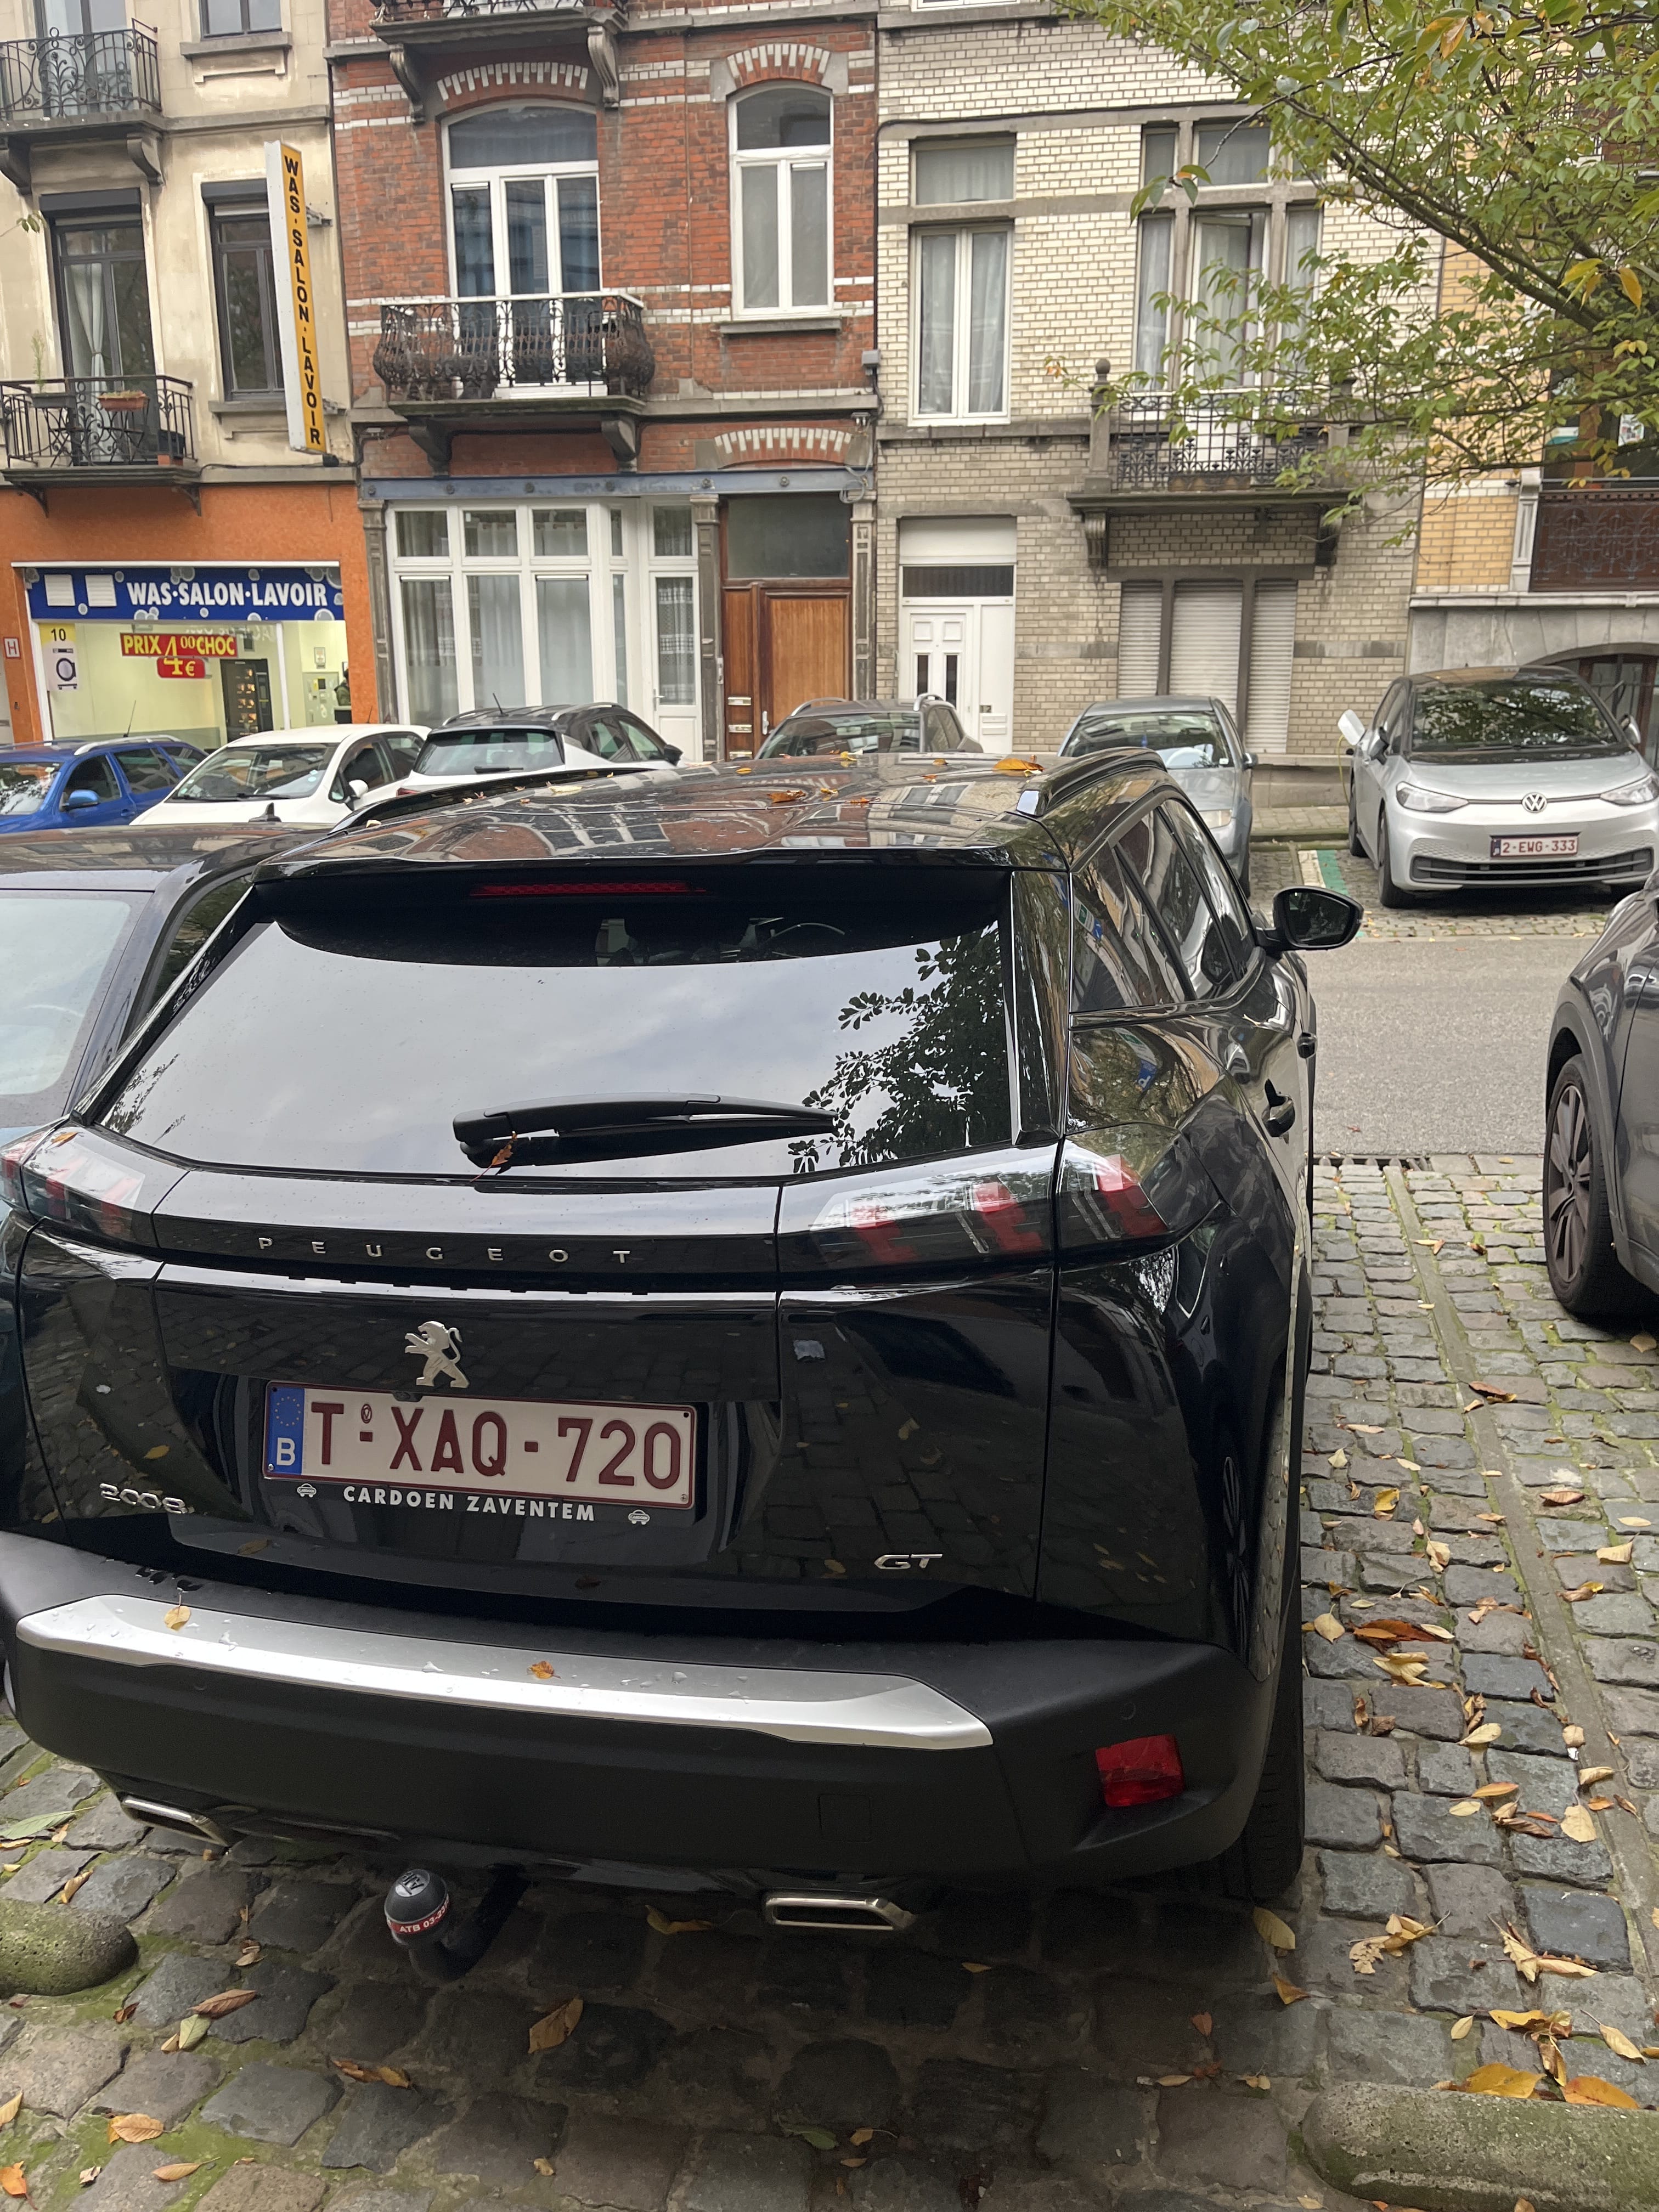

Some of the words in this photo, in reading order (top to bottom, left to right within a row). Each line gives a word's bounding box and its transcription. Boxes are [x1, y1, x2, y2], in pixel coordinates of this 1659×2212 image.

[51, 628, 66, 641] 10
[8, 640, 17, 655] H
[123, 635, 162, 654] PRIX
[196, 636, 235, 655] CHOC
[258, 1237, 630, 1263] PEUGEOT
[276, 1437, 295, 1466] B
[99, 1483, 186, 1514] 2008
[343, 1486, 454, 1510] CARDOEN
[466, 1496, 595, 1521] ZAVENTEM
[874, 1554, 943, 1570] GT
[399, 1924, 421, 1933] ATB
